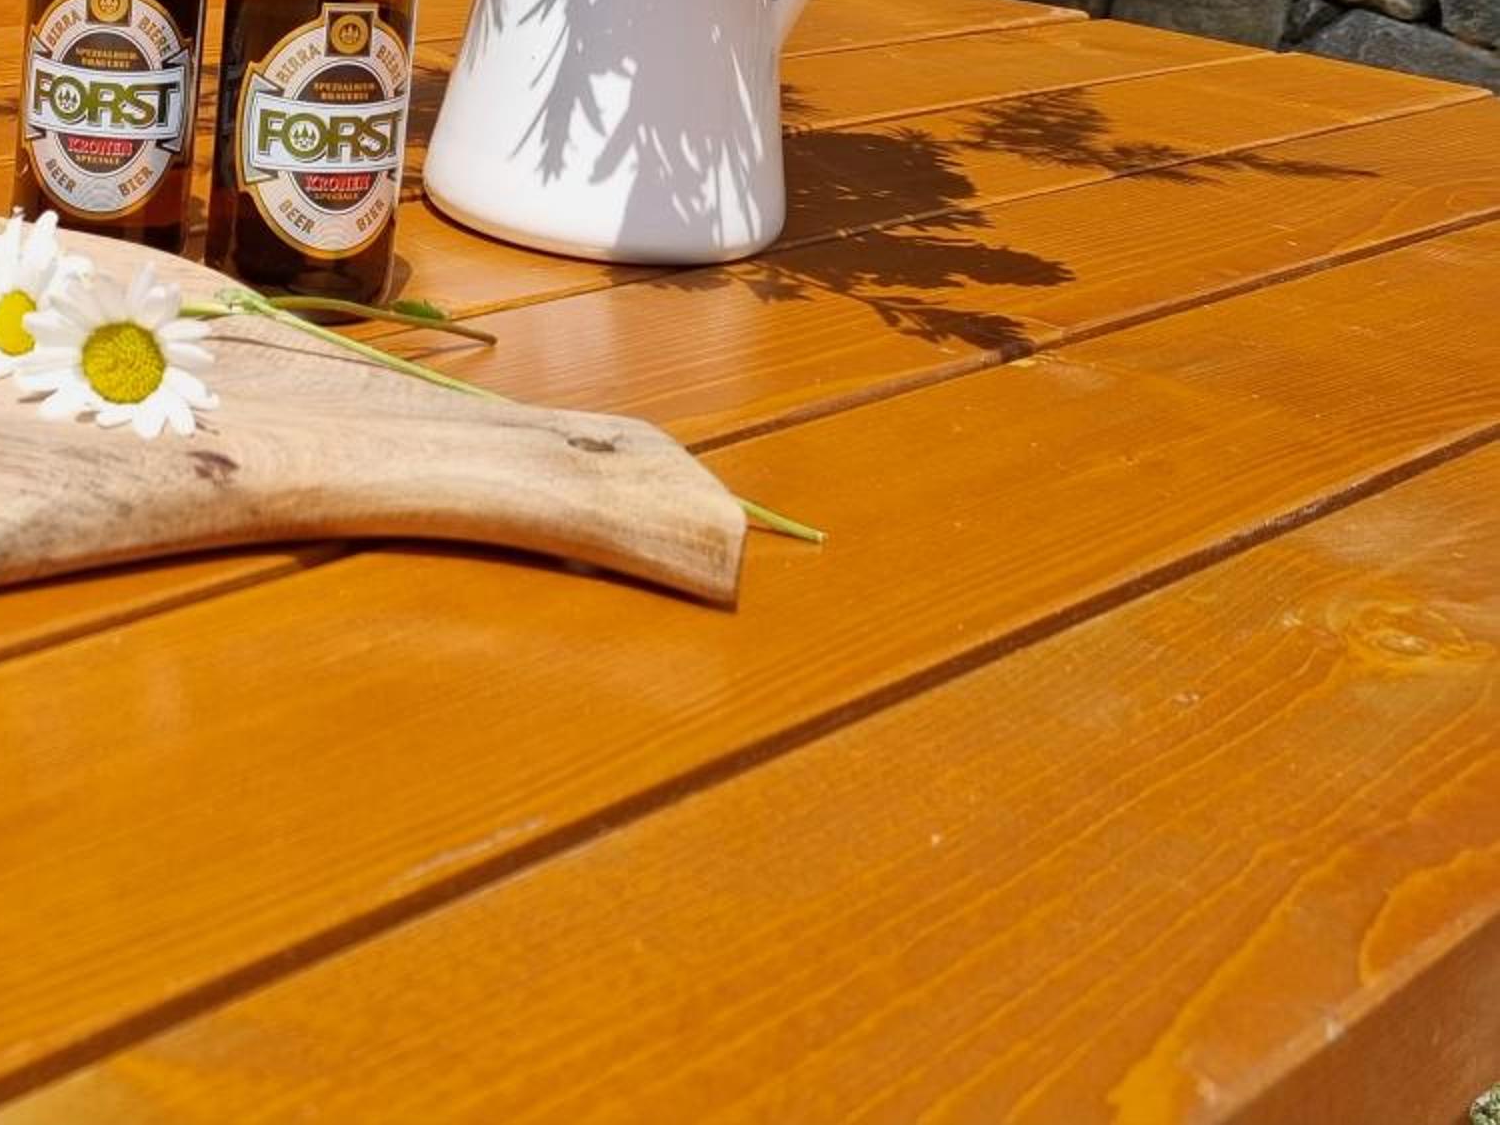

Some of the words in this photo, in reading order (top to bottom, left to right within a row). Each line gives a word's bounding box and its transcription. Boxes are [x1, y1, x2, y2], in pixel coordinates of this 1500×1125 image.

[44, 8, 83, 50] BIRRA
[274, 43, 322, 85] BIRRA
[34, 69, 180, 129] FORST
[67, 136, 133, 156] KRONEN
[257, 108, 404, 163] FORST
[45, 158, 78, 194] BEER
[117, 166, 155, 197] BIER
[305, 173, 373, 192] KRONEN
[279, 197, 316, 235] BEER
[356, 199, 386, 232] BIER
